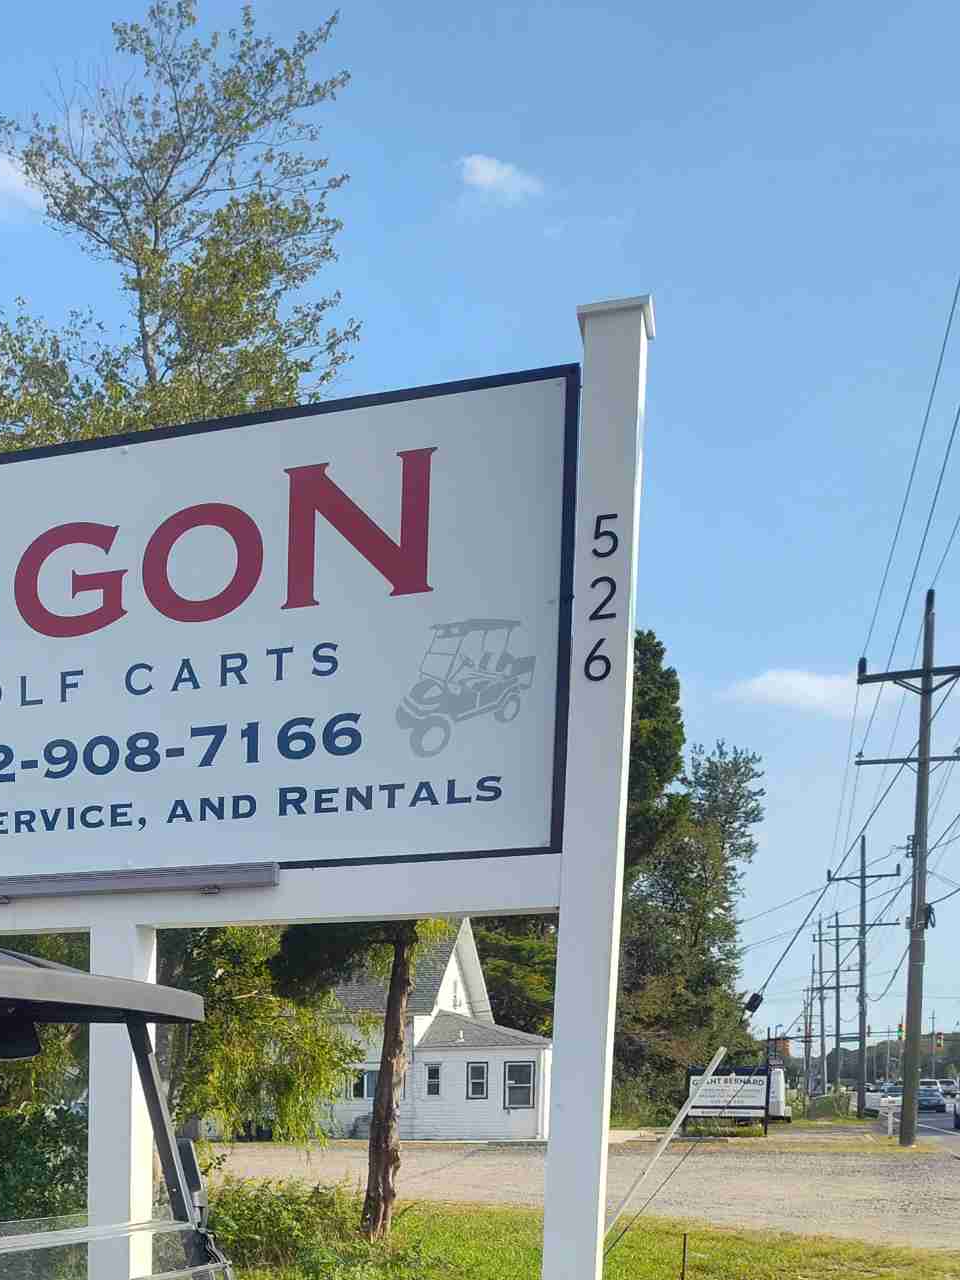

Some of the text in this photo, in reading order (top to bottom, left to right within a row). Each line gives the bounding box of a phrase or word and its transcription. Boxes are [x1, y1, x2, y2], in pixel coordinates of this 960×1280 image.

[124, 641, 341, 698] CARTS
[166, 794, 258, 825] AND
[278, 775, 504, 818] RENTALS
